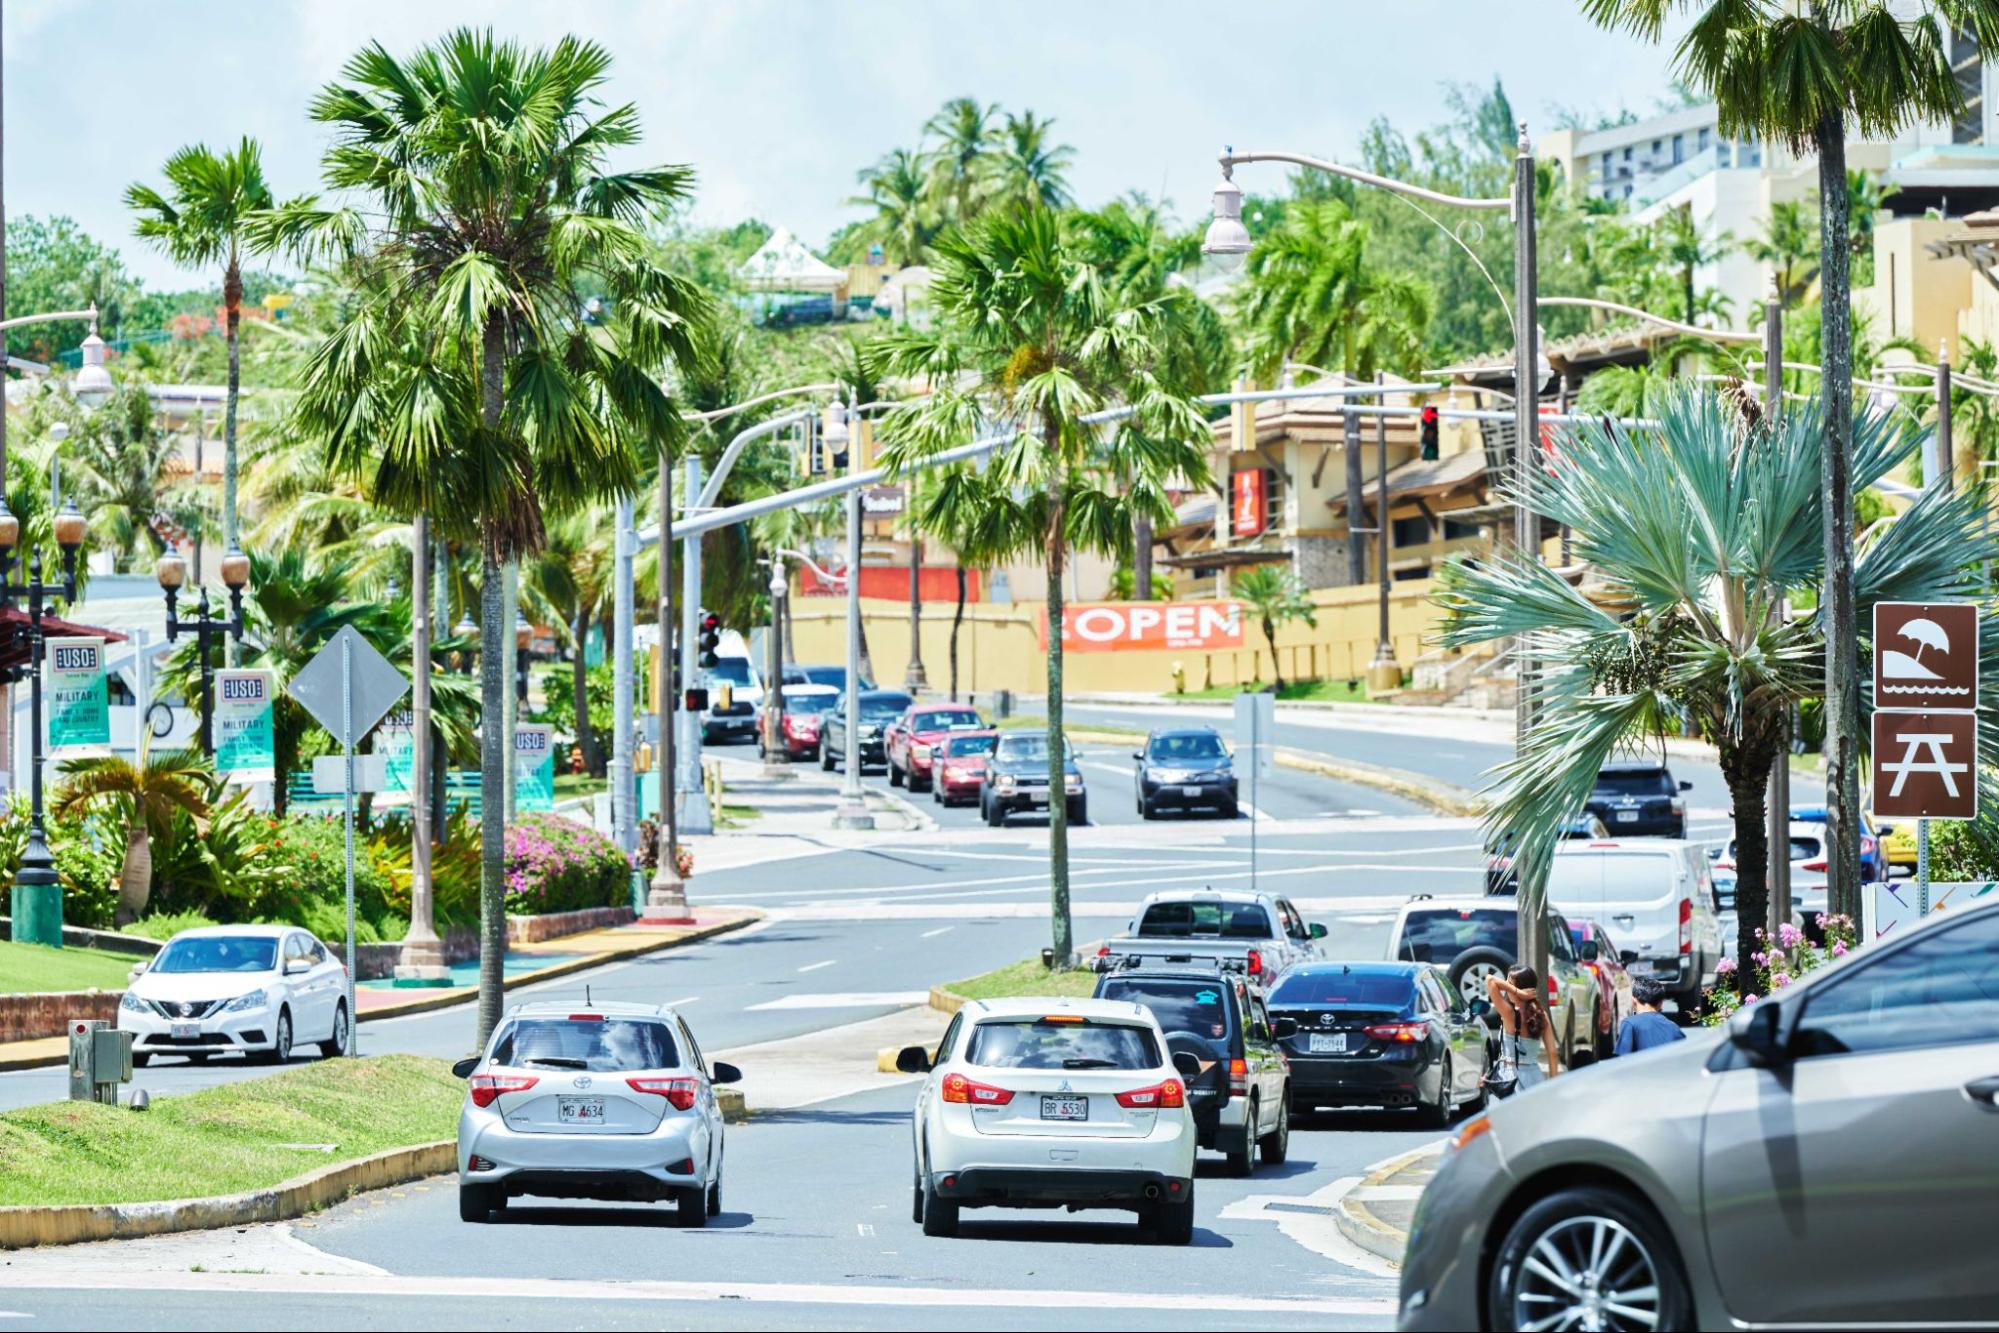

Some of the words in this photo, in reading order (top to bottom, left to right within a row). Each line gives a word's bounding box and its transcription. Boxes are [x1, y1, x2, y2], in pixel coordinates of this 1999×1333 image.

[1074, 604, 1240, 641] OPEN
[62, 648, 90, 667] USO
[230, 680, 257, 698] USO
[55, 691, 99, 702] MILITARY
[223, 720, 265, 729] MILITARY
[516, 733, 540, 749] USO
[562, 1105, 575, 1117] MG
[1044, 1103, 1057, 1115] BR
[1060, 1103, 1086, 1115] 5530
